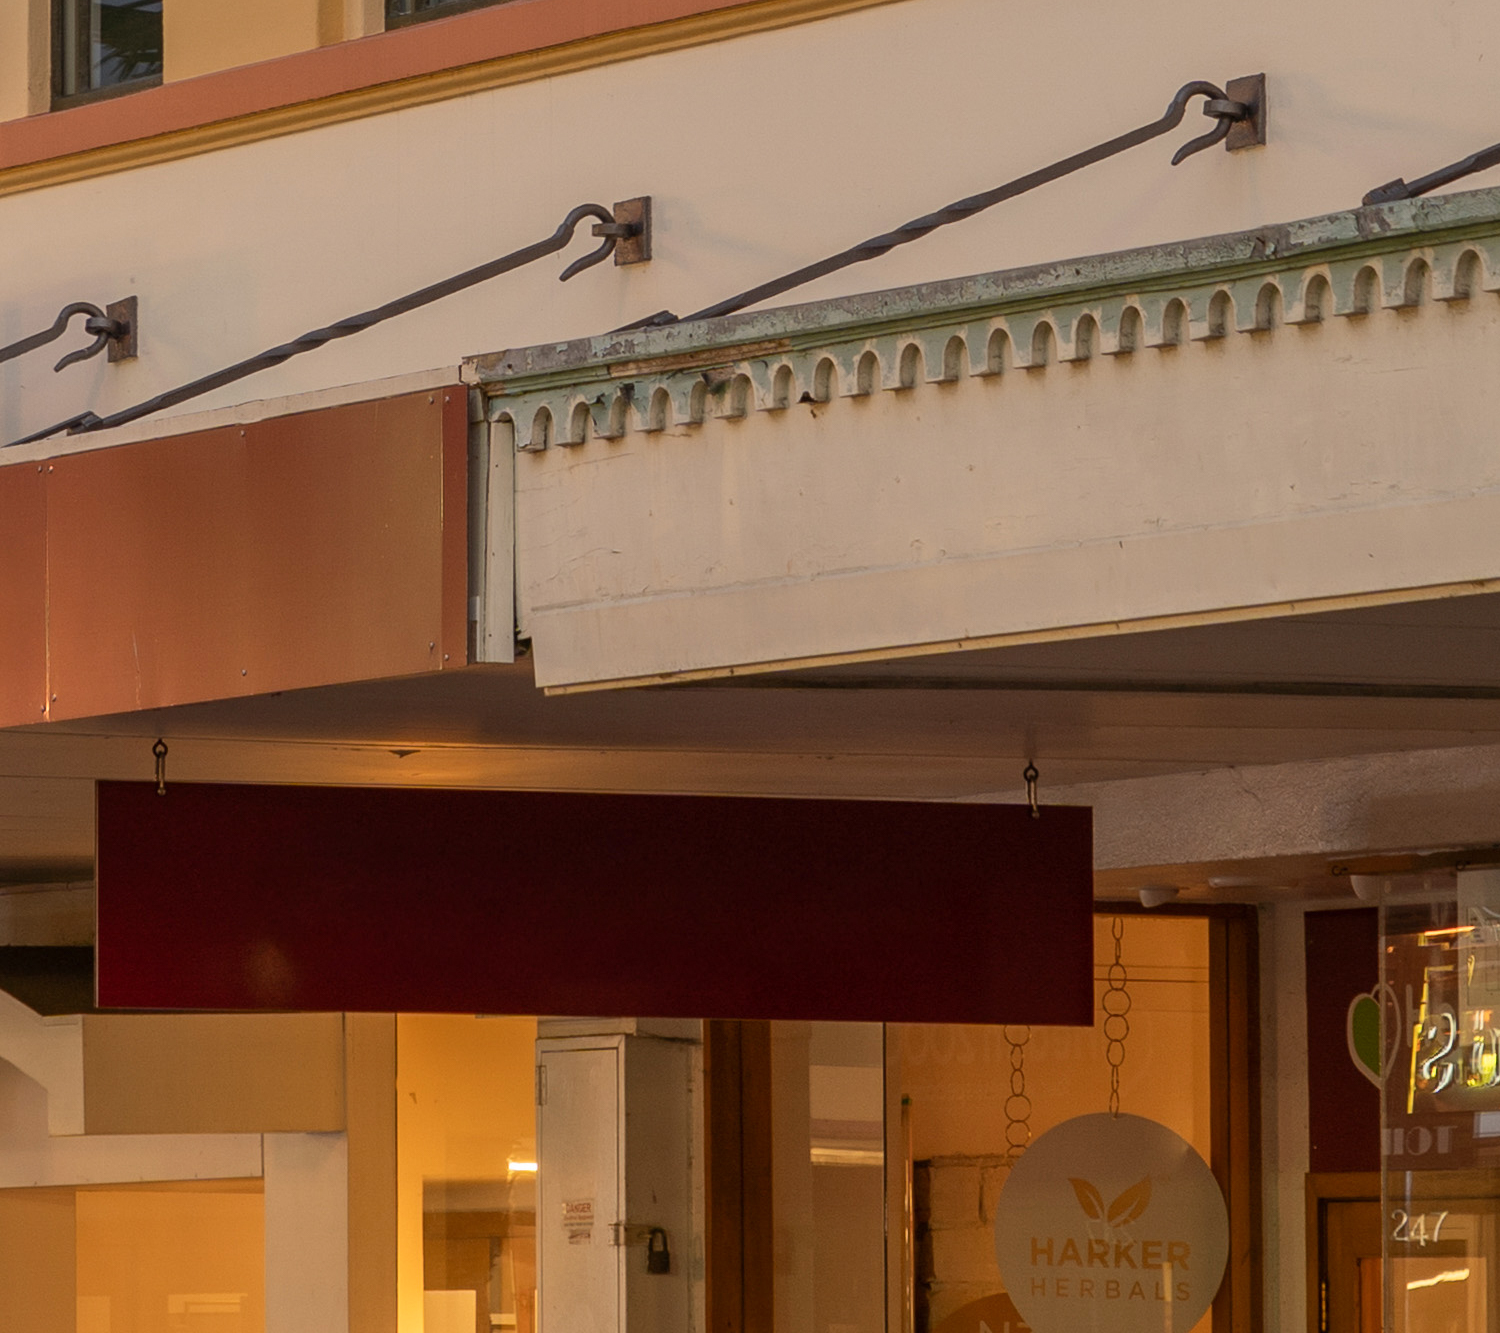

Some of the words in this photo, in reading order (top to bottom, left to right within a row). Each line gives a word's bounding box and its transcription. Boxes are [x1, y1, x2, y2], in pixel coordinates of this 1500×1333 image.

[1391, 1209, 1449, 1247] 247
[1030, 1237, 1191, 1271] HARKER
[1031, 1277, 1191, 1302] HERBALS
